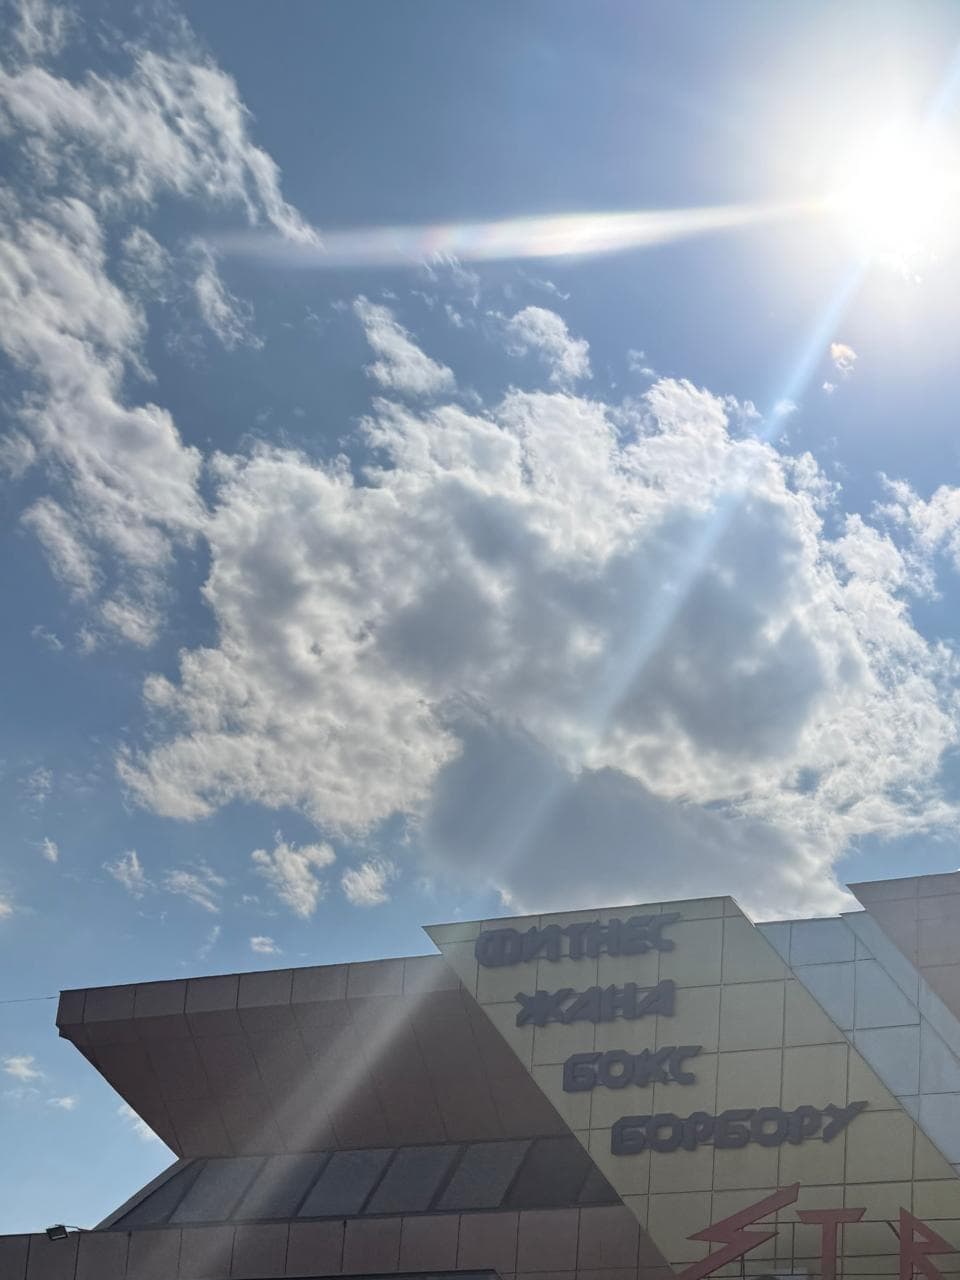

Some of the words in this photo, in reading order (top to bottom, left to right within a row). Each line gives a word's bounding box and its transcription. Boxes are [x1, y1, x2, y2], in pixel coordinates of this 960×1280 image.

[475, 912, 681, 967] ФИТНЕС
[514, 979, 676, 1028] ЖАНА
[563, 1045, 702, 1092] БОКС
[611, 1100, 869, 1156] БОРБОРУ
